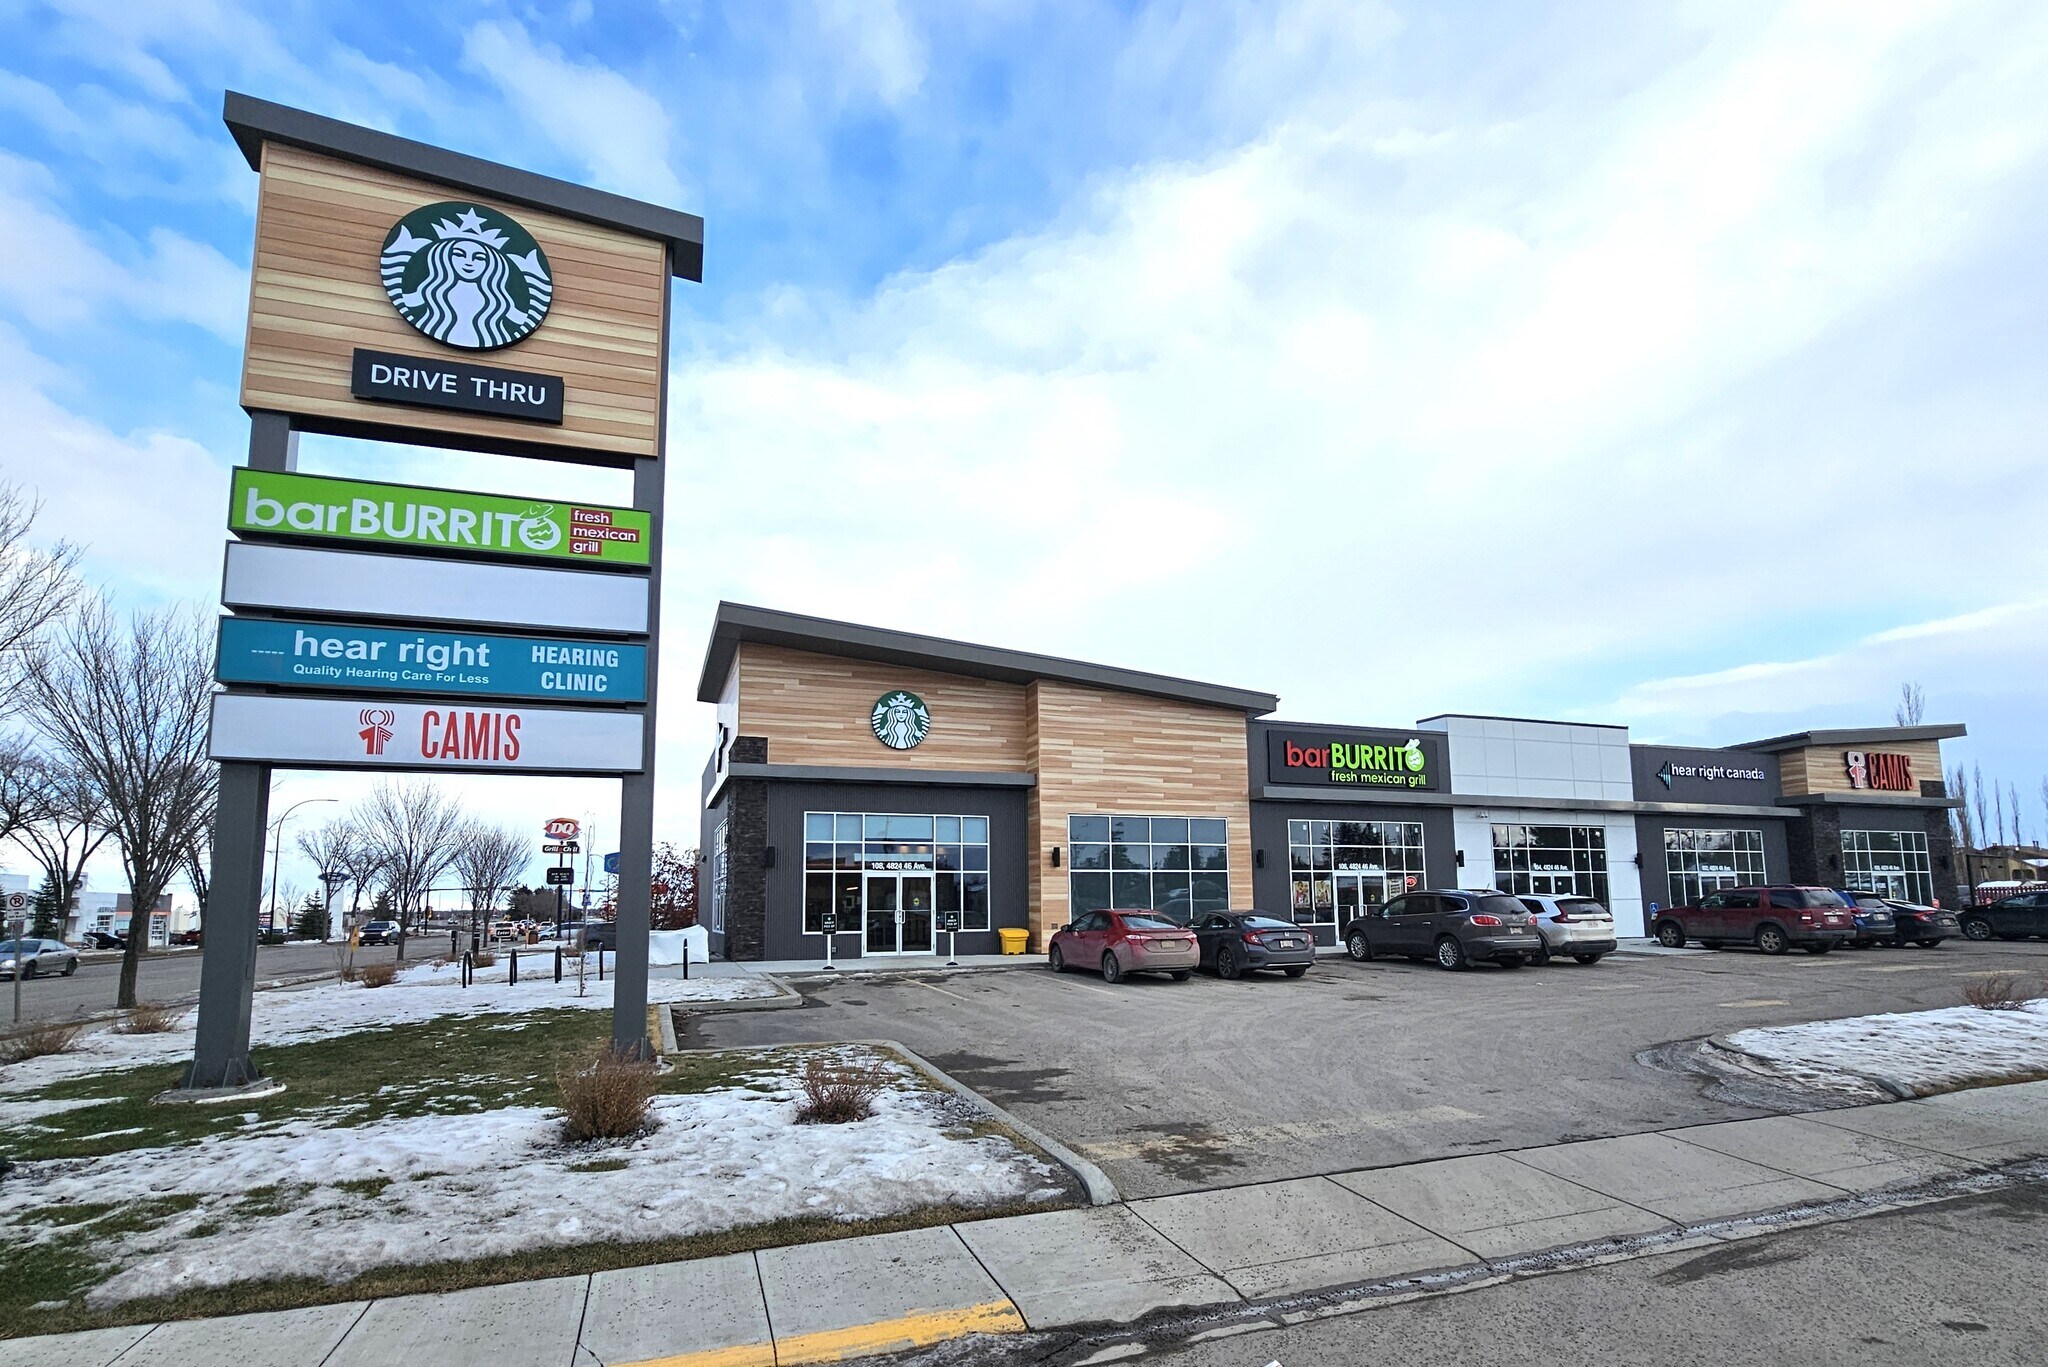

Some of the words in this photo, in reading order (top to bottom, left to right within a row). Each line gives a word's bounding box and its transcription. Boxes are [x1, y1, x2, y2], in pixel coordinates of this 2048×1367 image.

[371, 364, 457, 393] DRIVE
[470, 377, 546, 405] THRU
[574, 510, 610, 524] fresh
[573, 526, 637, 542] mexican
[573, 541, 599, 553] grill
[294, 630, 387, 661] hear
[399, 638, 490, 671] right
[531, 645, 619, 668] HEARING
[293, 663, 342, 678] Quality
[346, 667, 398, 681] Hearing
[401, 669, 432, 681] Care
[436, 672, 456, 682] For
[459, 673, 490, 684] Less
[541, 671, 608, 692] CLINIC
[421, 710, 521, 761] CAMIS
[1331, 770, 1358, 783] fresh
[1361, 772, 1406, 785] mexican
[1408, 774, 1426, 788] grill
[1671, 763, 1697, 776] hear
[1699, 765, 1724, 780] right
[1726, 768, 1765, 780] canada
[1869, 752, 1914, 791] CAMIS
[550, 822, 575, 835] DQ
[886, 862, 902, 870] 4824
[903, 862, 912, 870] 46
[913, 862, 927, 870] Ave.
